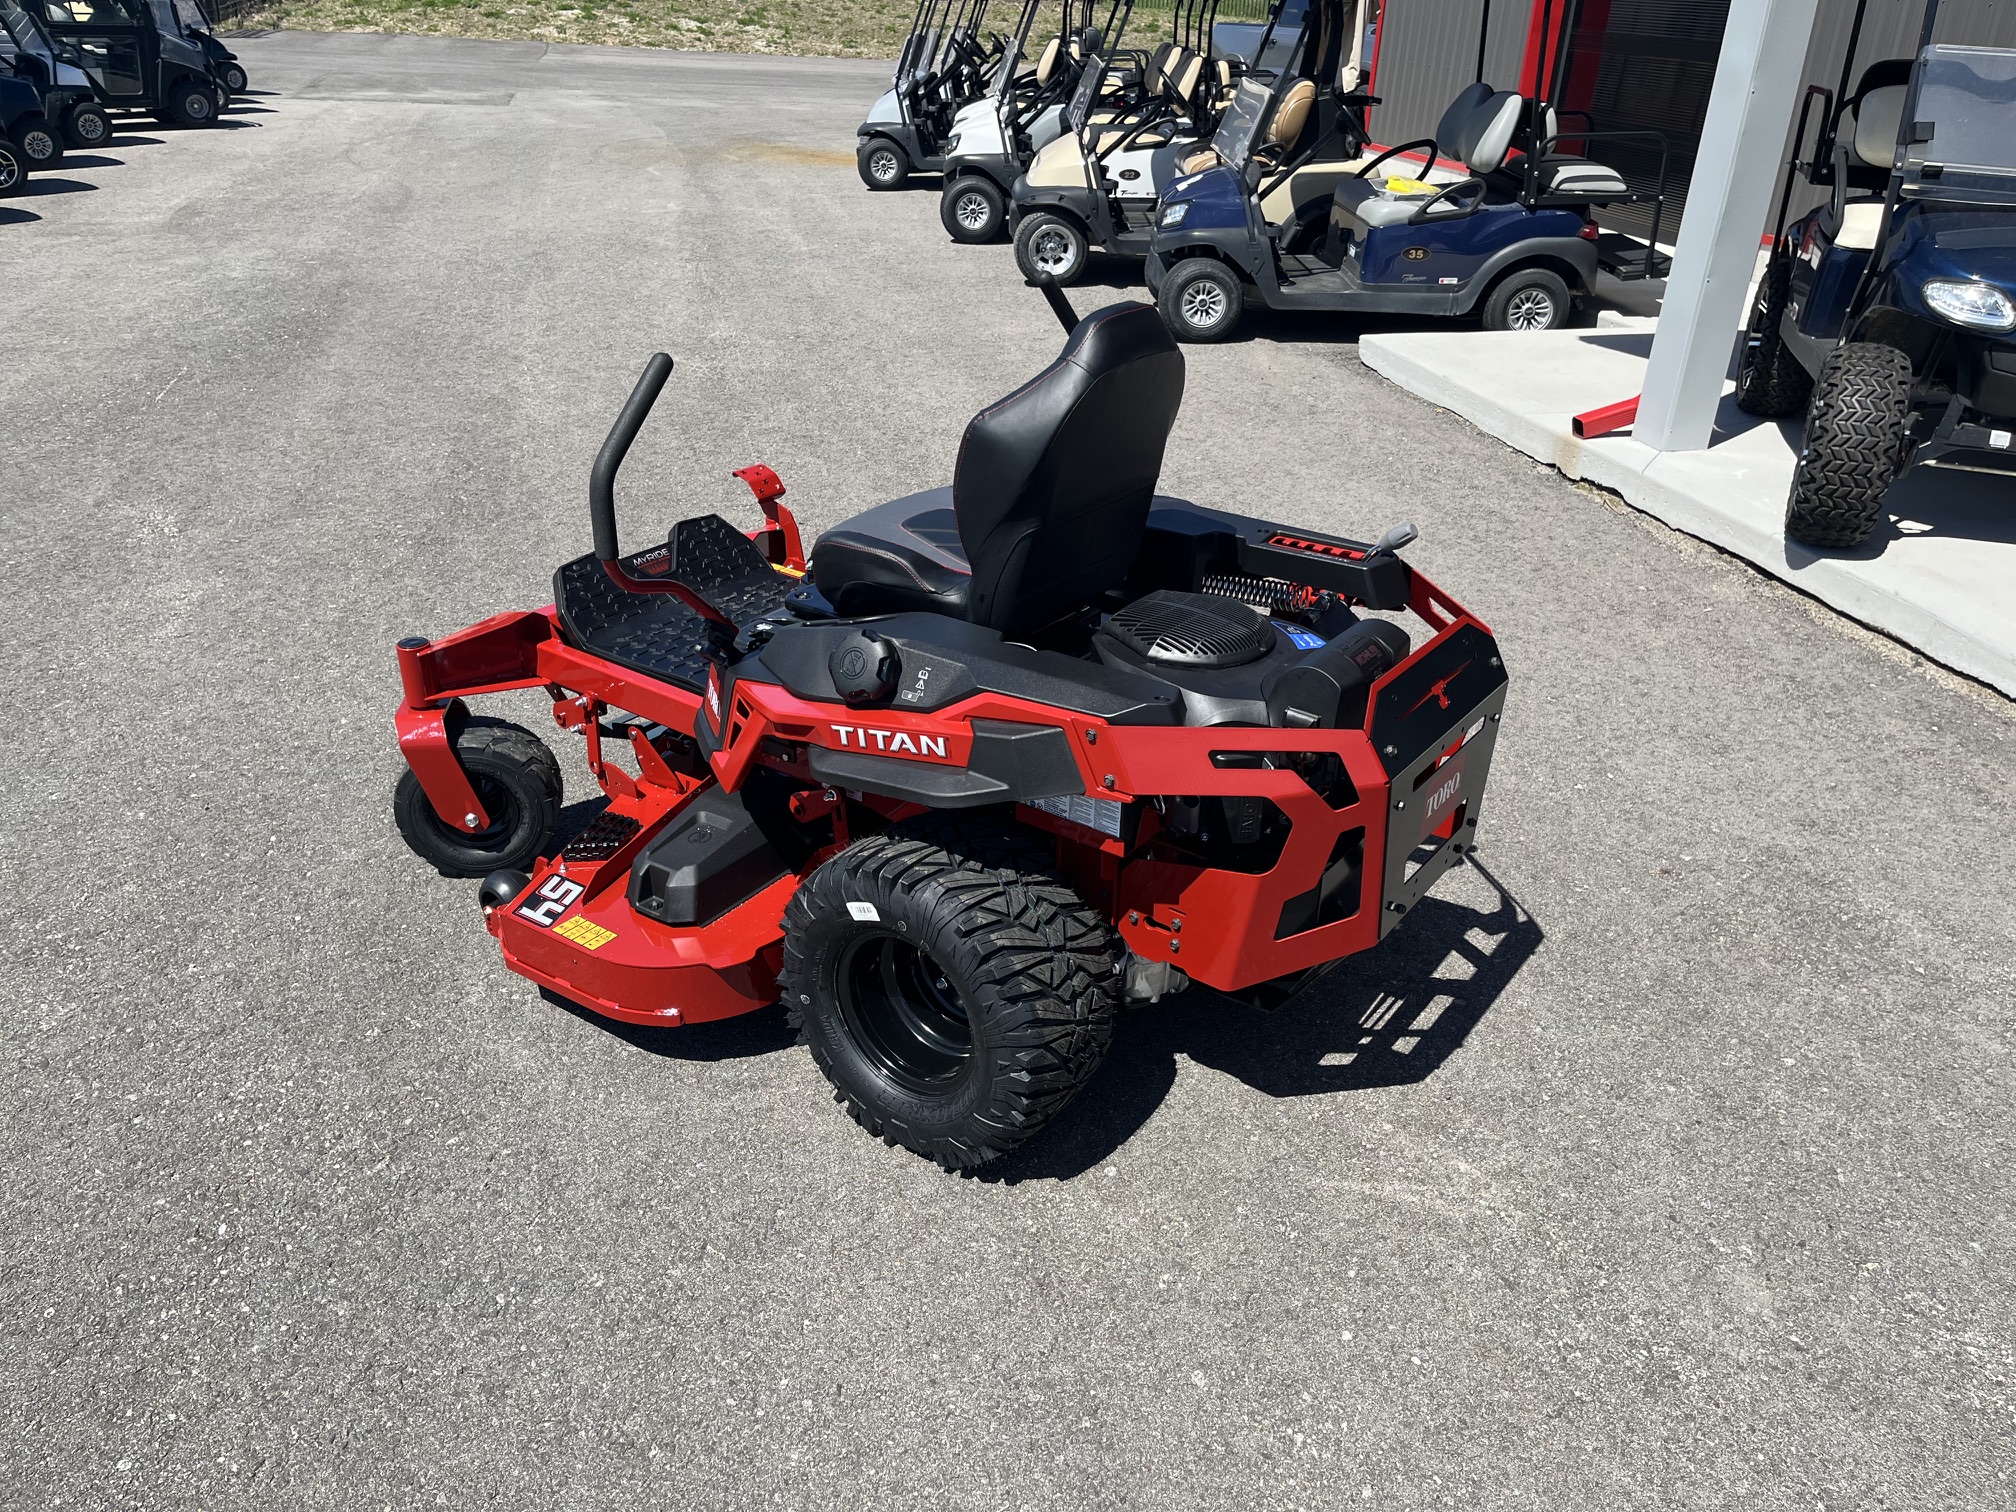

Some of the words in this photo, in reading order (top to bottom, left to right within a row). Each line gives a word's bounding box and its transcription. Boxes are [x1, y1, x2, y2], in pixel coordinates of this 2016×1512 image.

[1124, 171, 1135, 179] 22
[1408, 249, 1424, 259] 35
[830, 724, 947, 758] TITAN
[1425, 772, 1460, 819] TORO
[516, 874, 585, 927] 54
